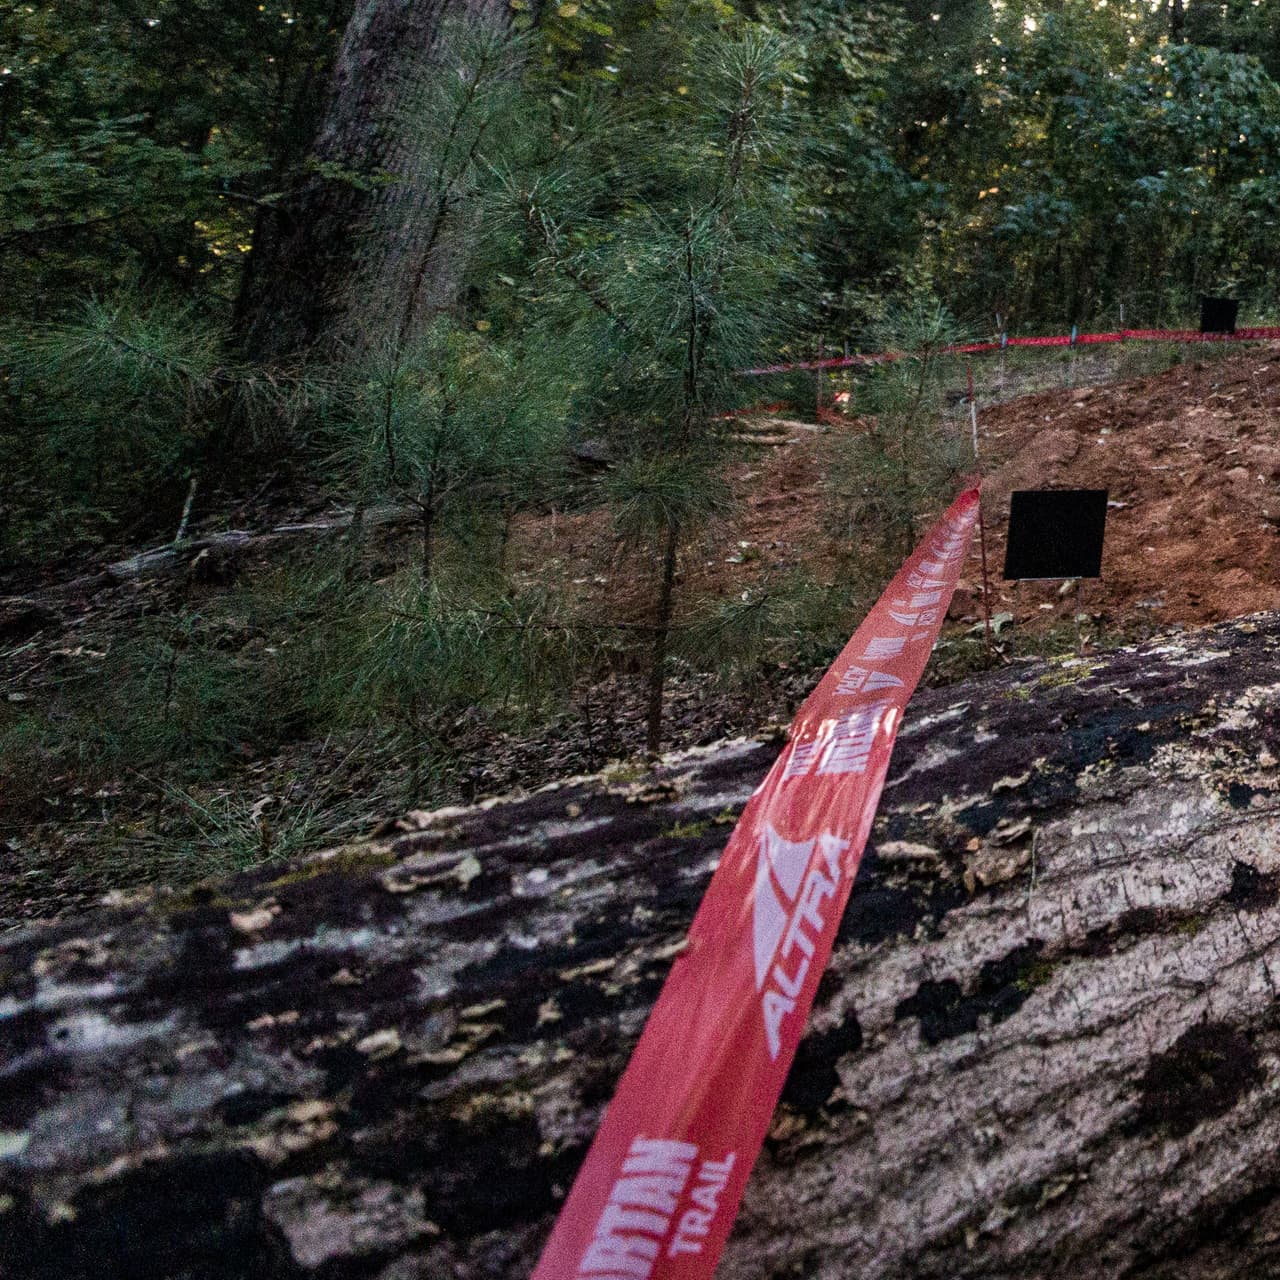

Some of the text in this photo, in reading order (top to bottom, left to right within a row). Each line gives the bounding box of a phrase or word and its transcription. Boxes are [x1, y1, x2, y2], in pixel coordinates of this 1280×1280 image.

[762, 832, 850, 1062] ALTRA
[576, 1134, 699, 1280] RTAN
[668, 1152, 736, 1257] TRAIL
